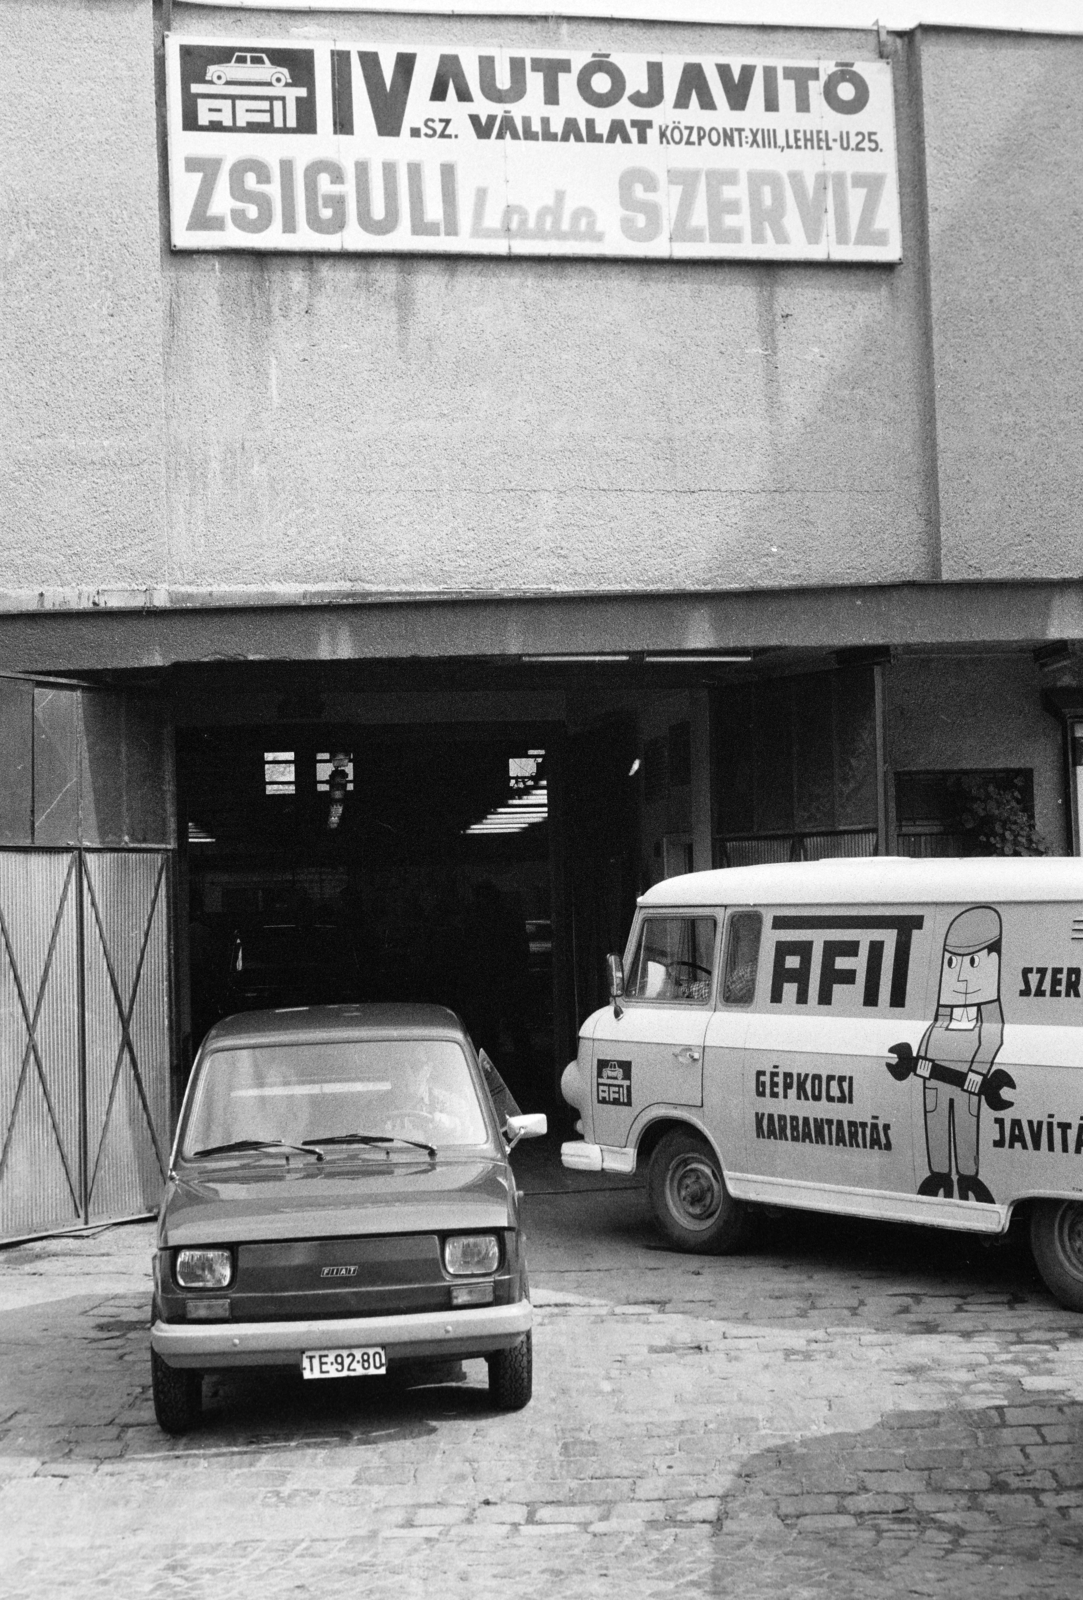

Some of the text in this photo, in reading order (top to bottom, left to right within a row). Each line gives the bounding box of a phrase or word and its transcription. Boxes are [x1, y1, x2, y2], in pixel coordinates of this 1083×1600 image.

[184, 155, 891, 247] ZSIGULI Lada SZERVIZ
[770, 915, 925, 1008] AFIT
[755, 1064, 854, 1104] GÉPKOCSI
[754, 1111, 893, 1151] KARBANTARTÁS
[322, 1266, 358, 1277] FIAT
